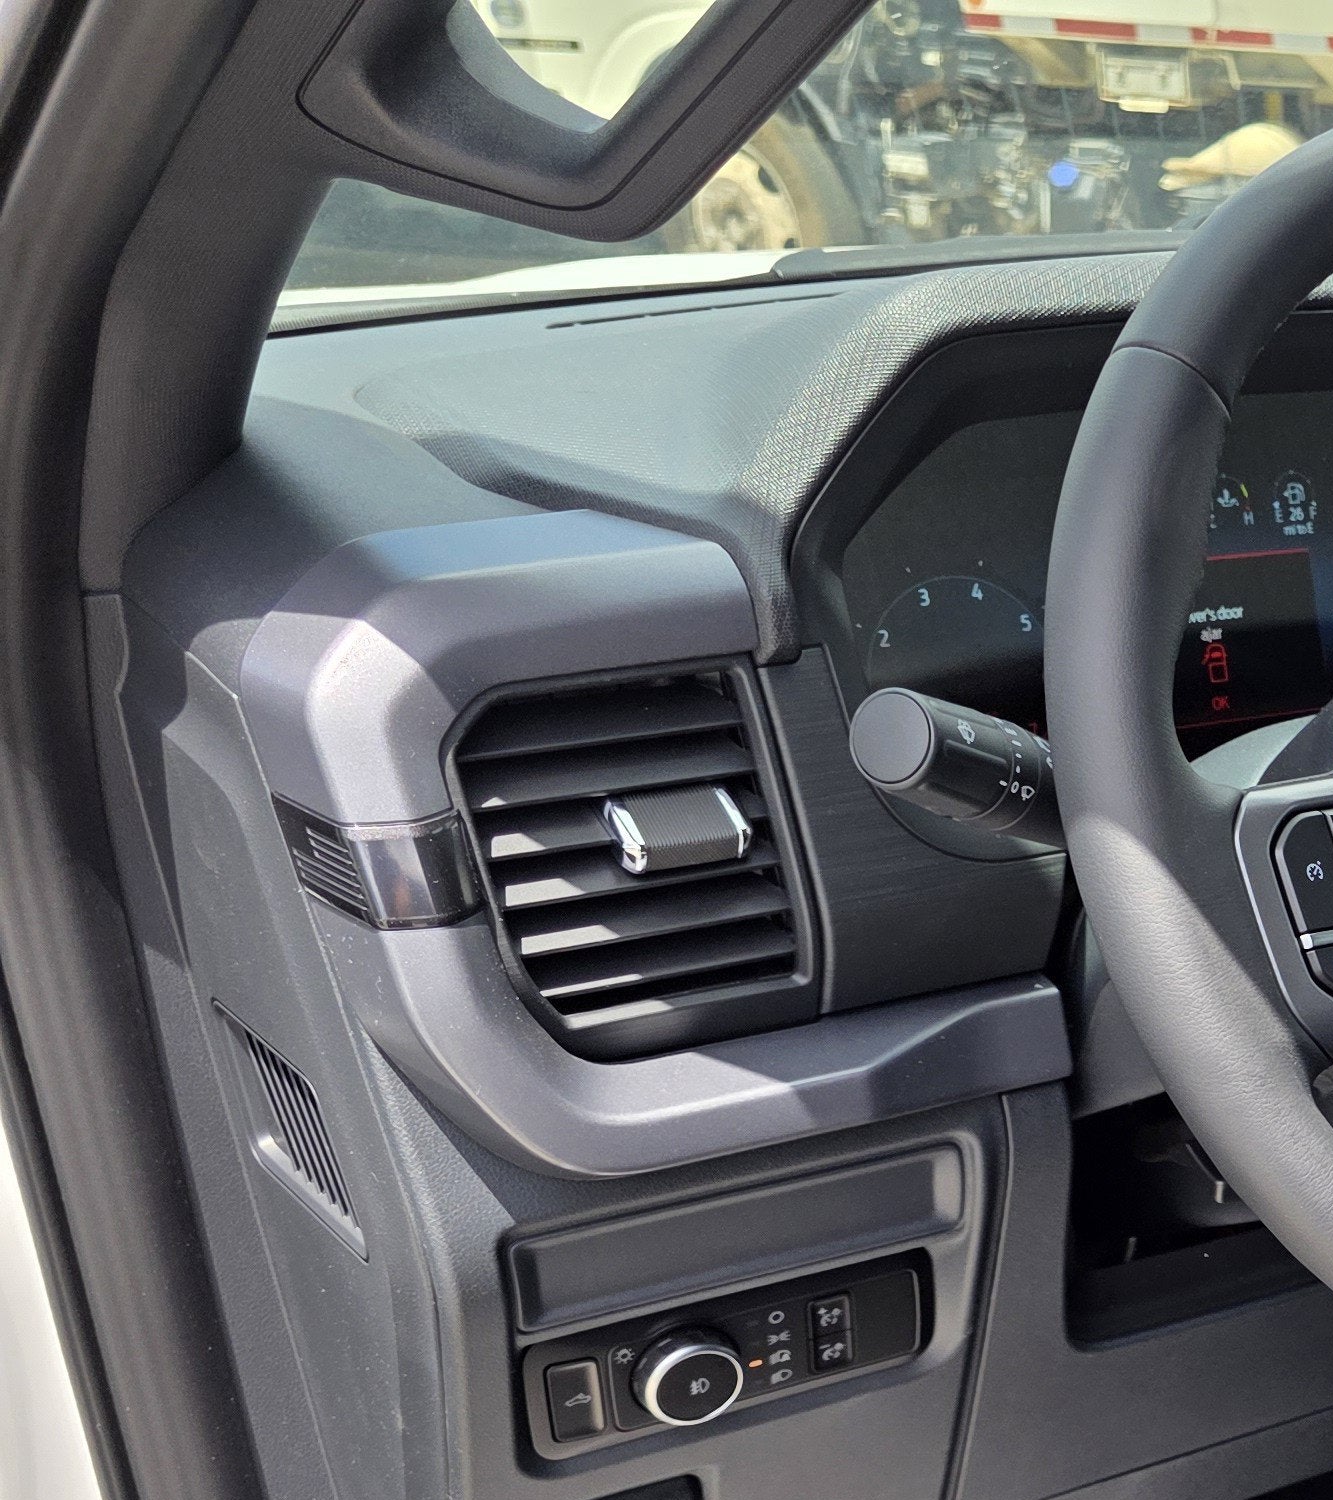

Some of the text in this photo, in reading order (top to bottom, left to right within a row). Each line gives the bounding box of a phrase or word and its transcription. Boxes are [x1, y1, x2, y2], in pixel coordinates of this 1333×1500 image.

[1242, 511, 1255, 526] H
[917, 588, 930, 606] 3
[971, 582, 983, 600] 4
[1217, 605, 1244, 620] door
[1020, 613, 1032, 632] 5
[877, 629, 891, 647] 2
